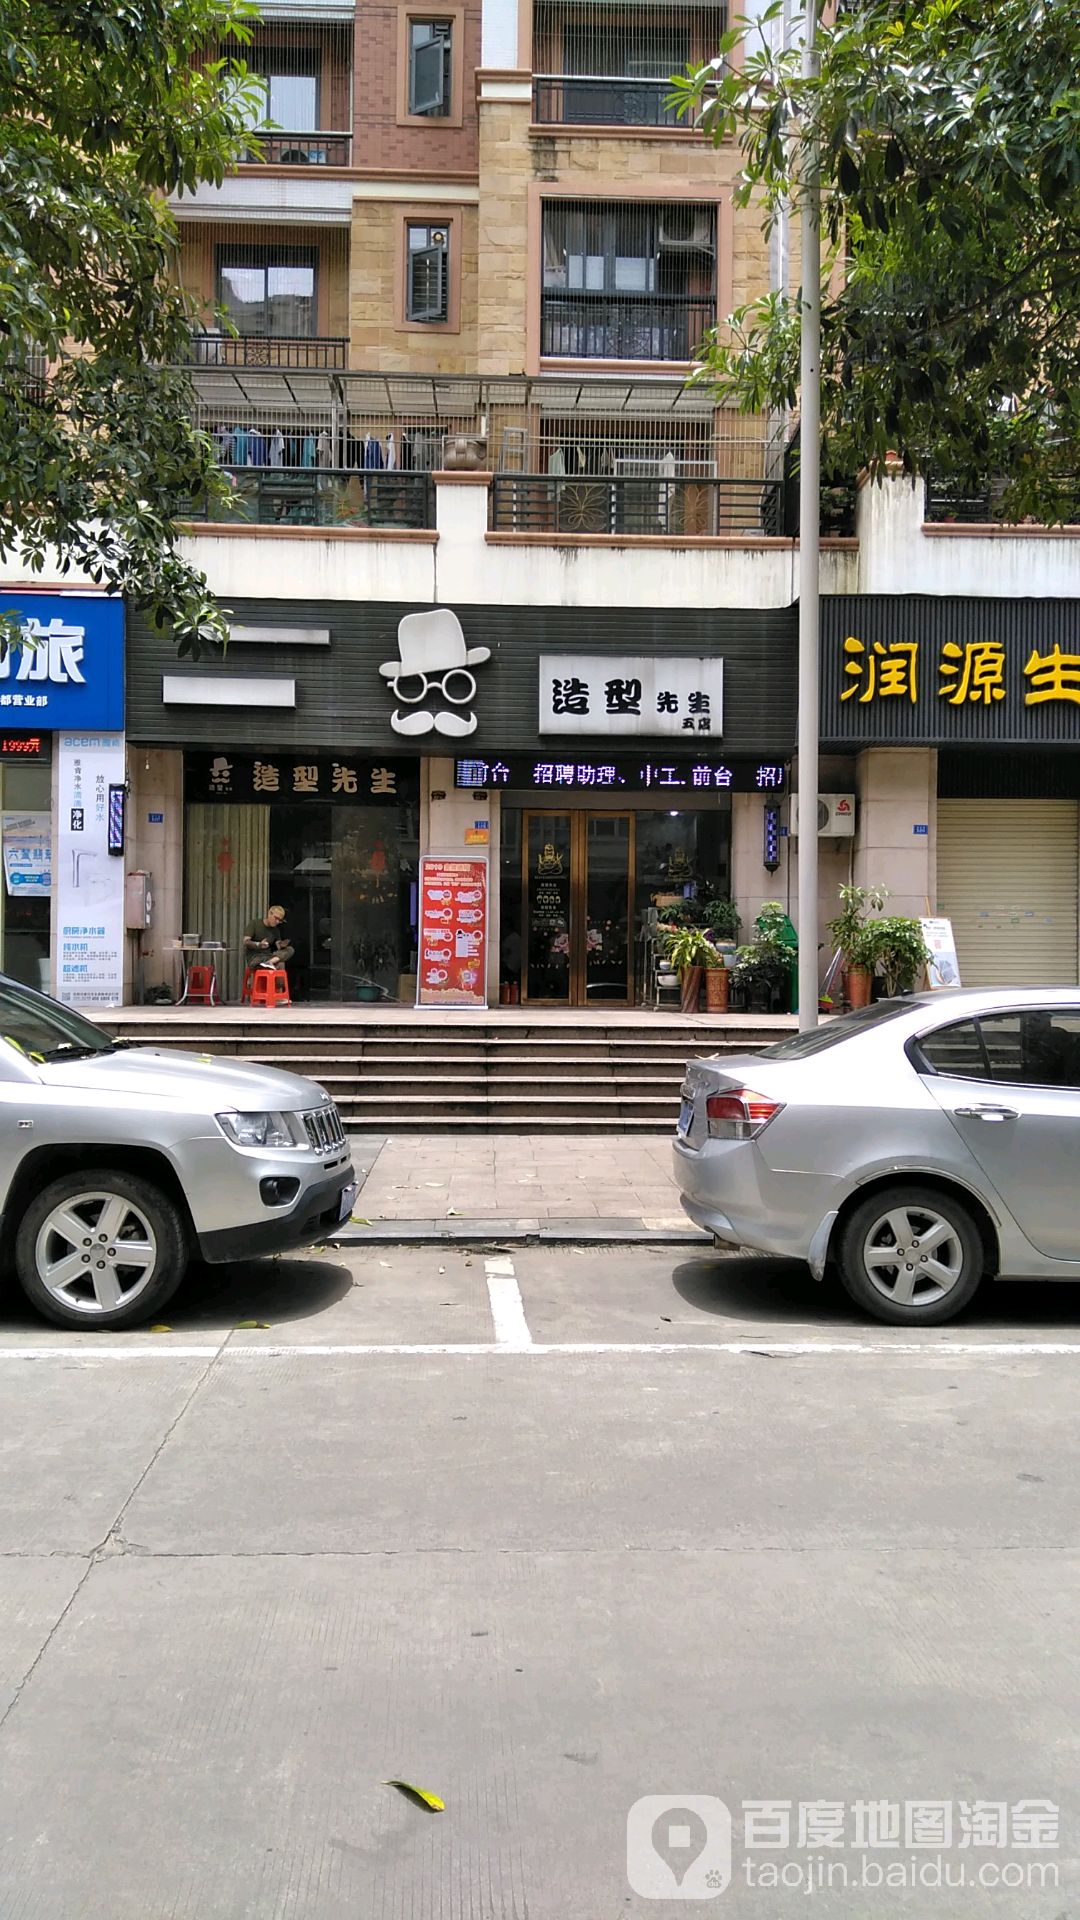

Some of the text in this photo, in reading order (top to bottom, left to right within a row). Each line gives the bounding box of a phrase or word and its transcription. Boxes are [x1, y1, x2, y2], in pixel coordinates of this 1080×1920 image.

[841, 637, 1080, 704] 润源生
[552, 678, 710, 715] 造型先生
[682, 717, 711, 731] 五店
[252, 763, 397, 794] 造型先生
